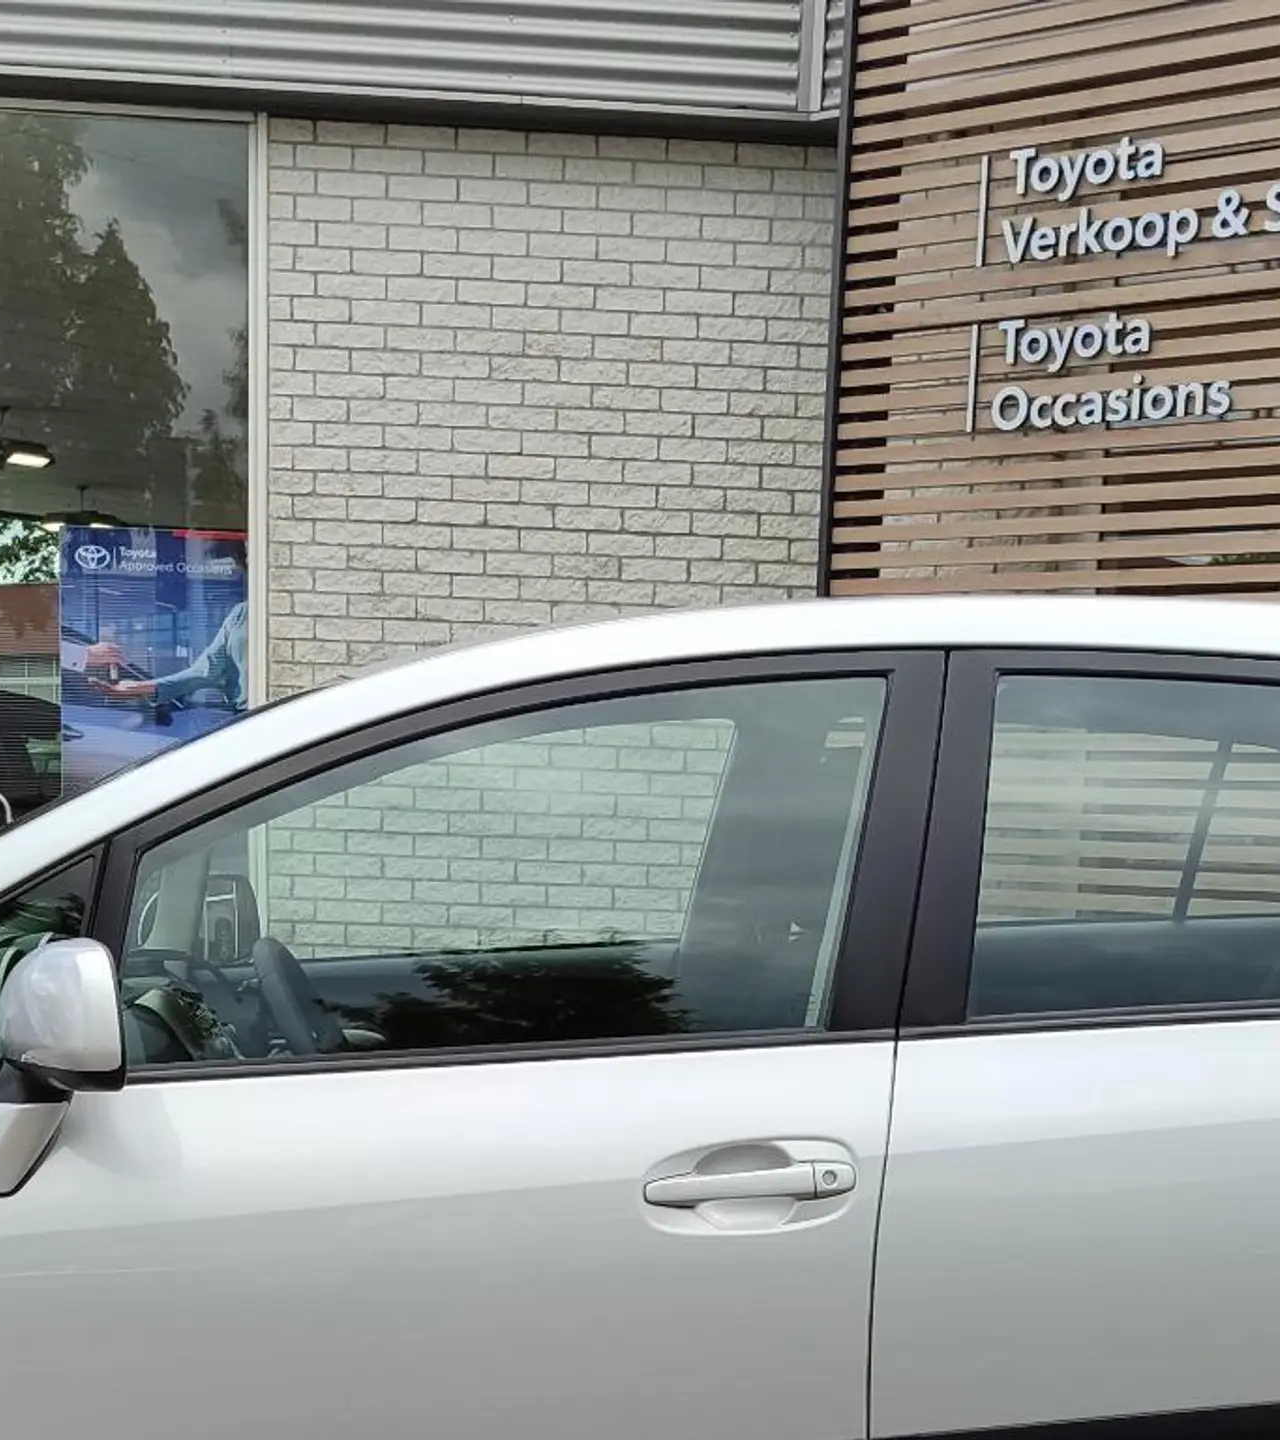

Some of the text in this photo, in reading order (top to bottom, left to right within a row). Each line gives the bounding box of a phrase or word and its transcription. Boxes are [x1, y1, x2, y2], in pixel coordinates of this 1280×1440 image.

[1009, 136, 1165, 201] Toyota
[1003, 206, 1200, 264] Verkoop
[1212, 186, 1251, 239] &
[999, 312, 1153, 373] Toyota
[991, 374, 1232, 432] Occasions
[119, 545, 157, 560] Toyota
[119, 561, 174, 573] Approved
